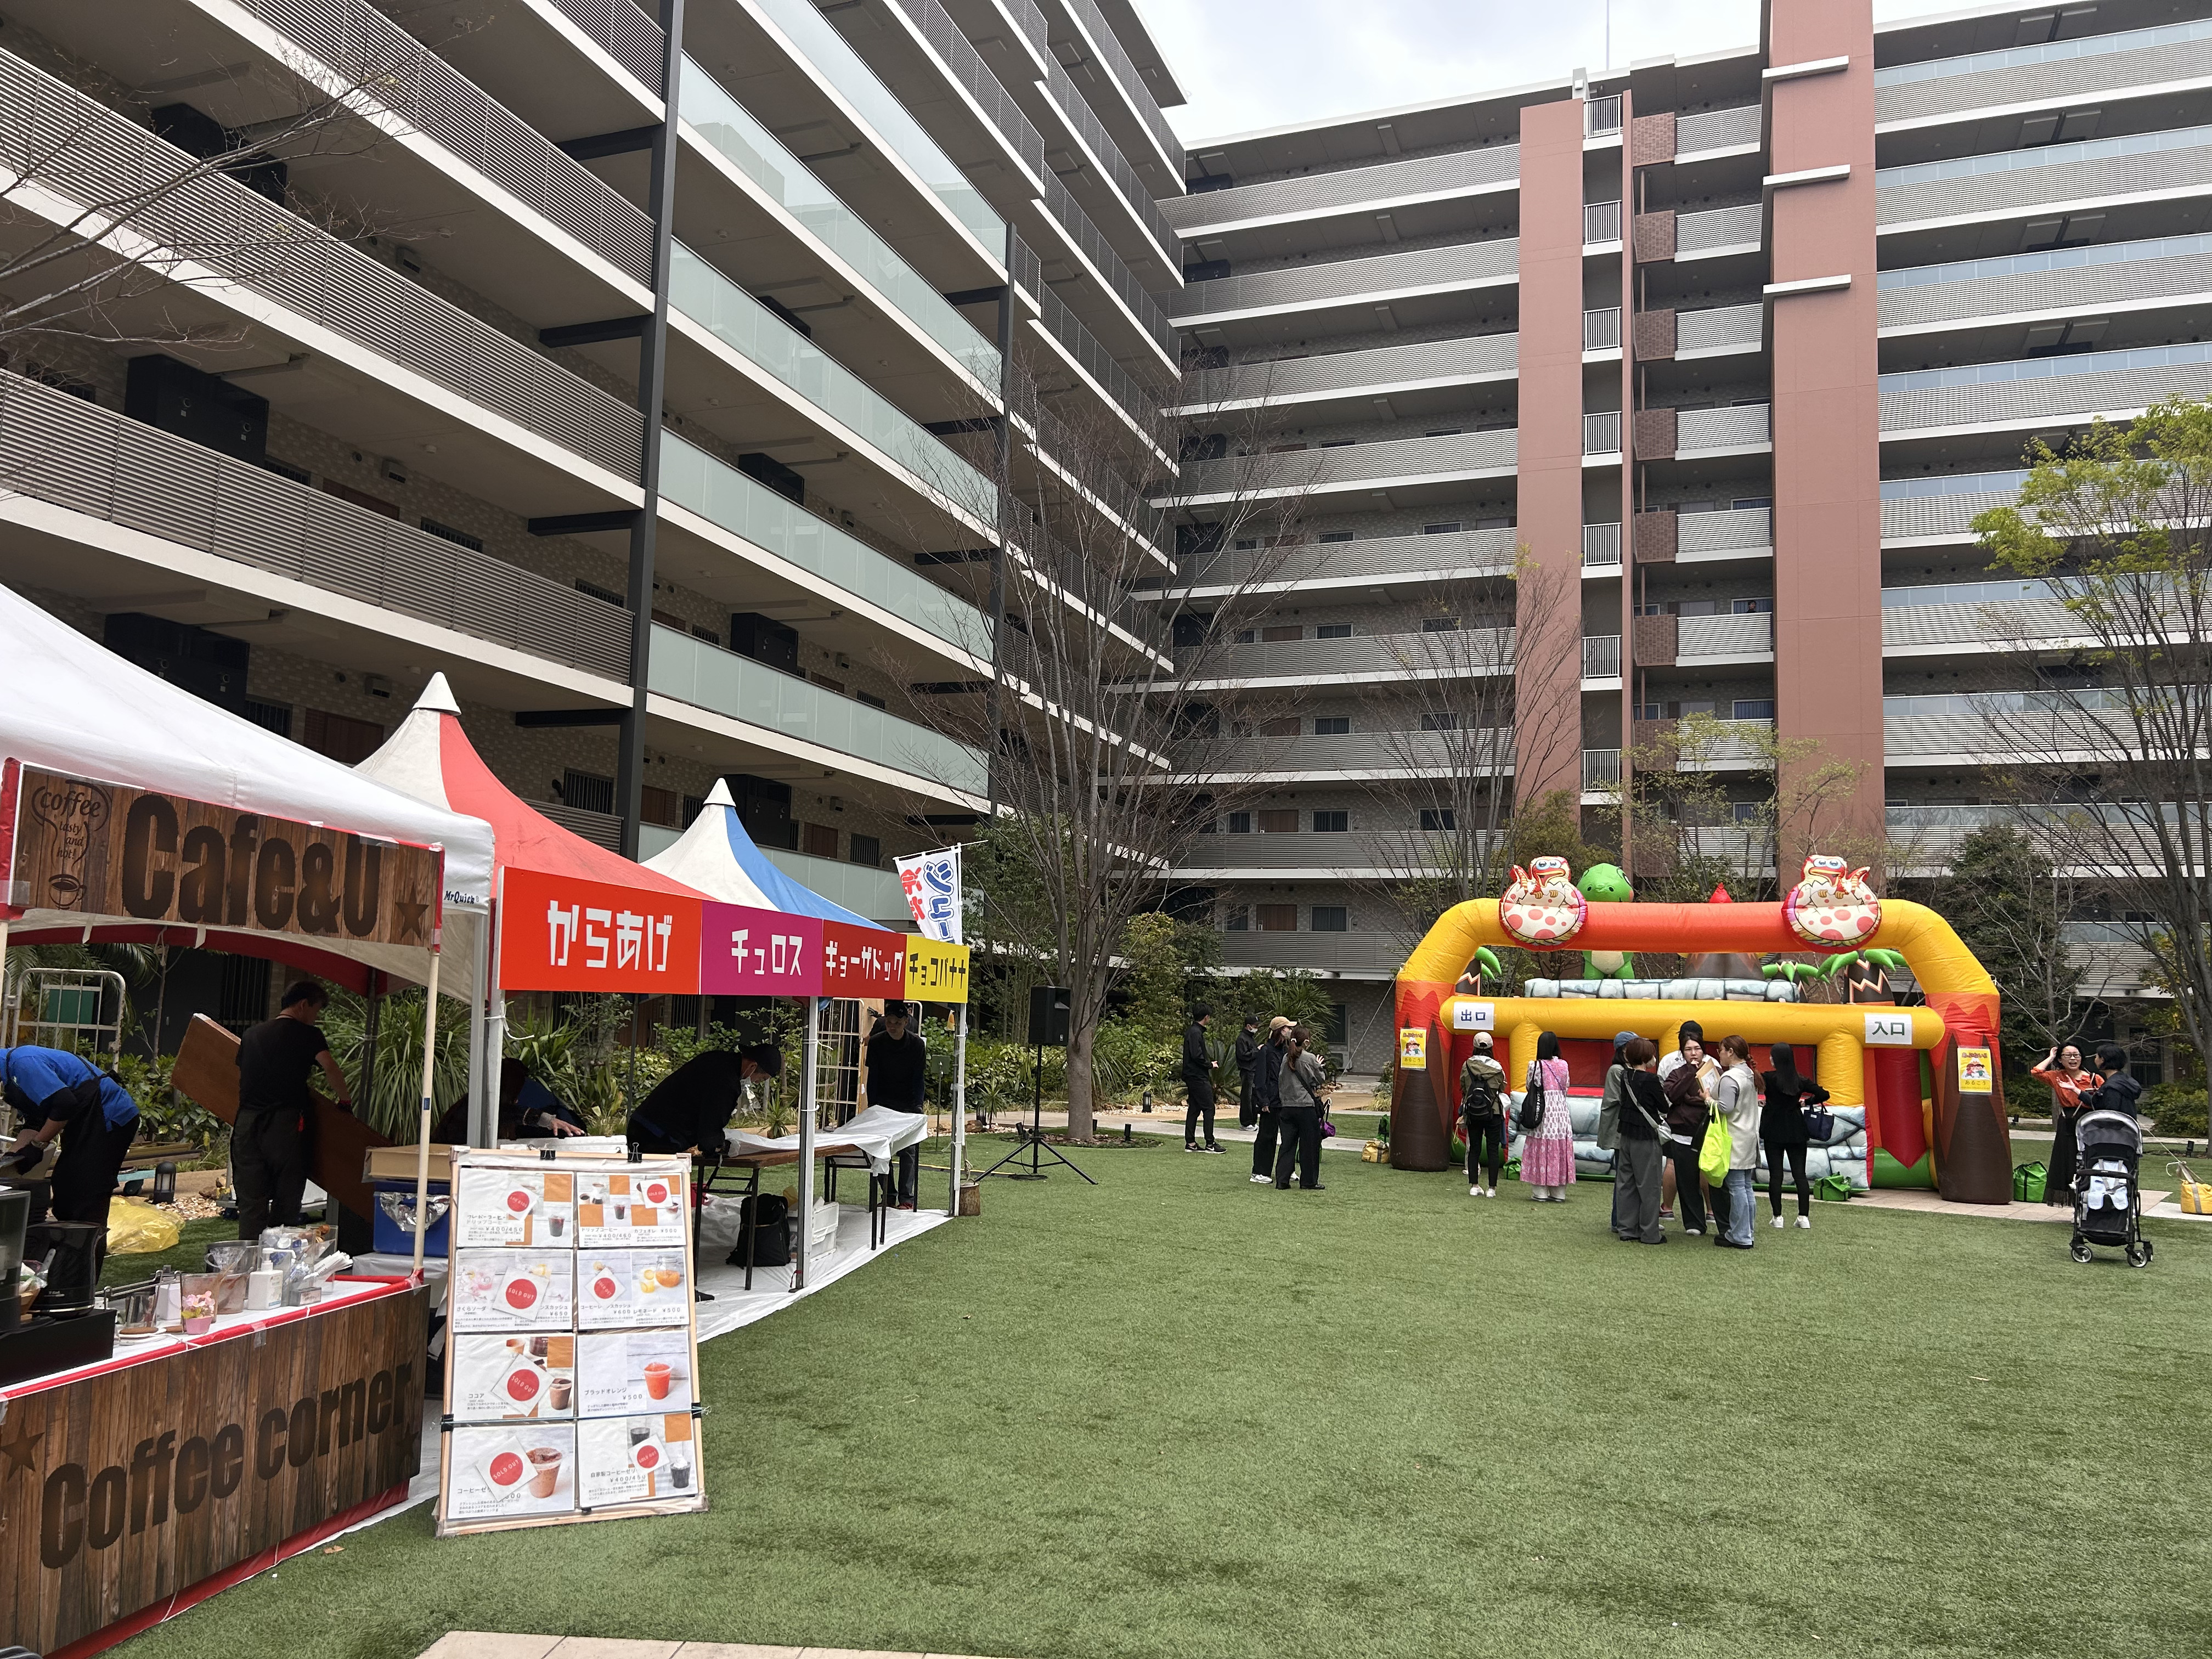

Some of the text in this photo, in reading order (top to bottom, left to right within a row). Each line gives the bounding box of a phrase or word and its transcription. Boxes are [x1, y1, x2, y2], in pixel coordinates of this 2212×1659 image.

[40, 791, 101, 817] coffee
[59, 821, 82, 836] tasty
[66, 837, 84, 847] and
[57, 847, 76, 860] hot!
[121, 794, 382, 938] Cafe&U
[548, 900, 673, 972] からあげ
[731, 929, 803, 977] チュロス
[826, 940, 904, 981] ギョーザドッグ
[909, 952, 966, 989] チョコバナナ
[1461, 1009, 1486, 1022] 出口
[1872, 1021, 1905, 1036] 入口
[508, 1287, 522, 1296] SOLD
[511, 1375, 535, 1394] SOLD OUT
[584, 1387, 627, 1396] ブラッドオレンジ
[40, 1361, 412, 1569] Coffee corner
[493, 1459, 520, 1480] SOLD OUT
